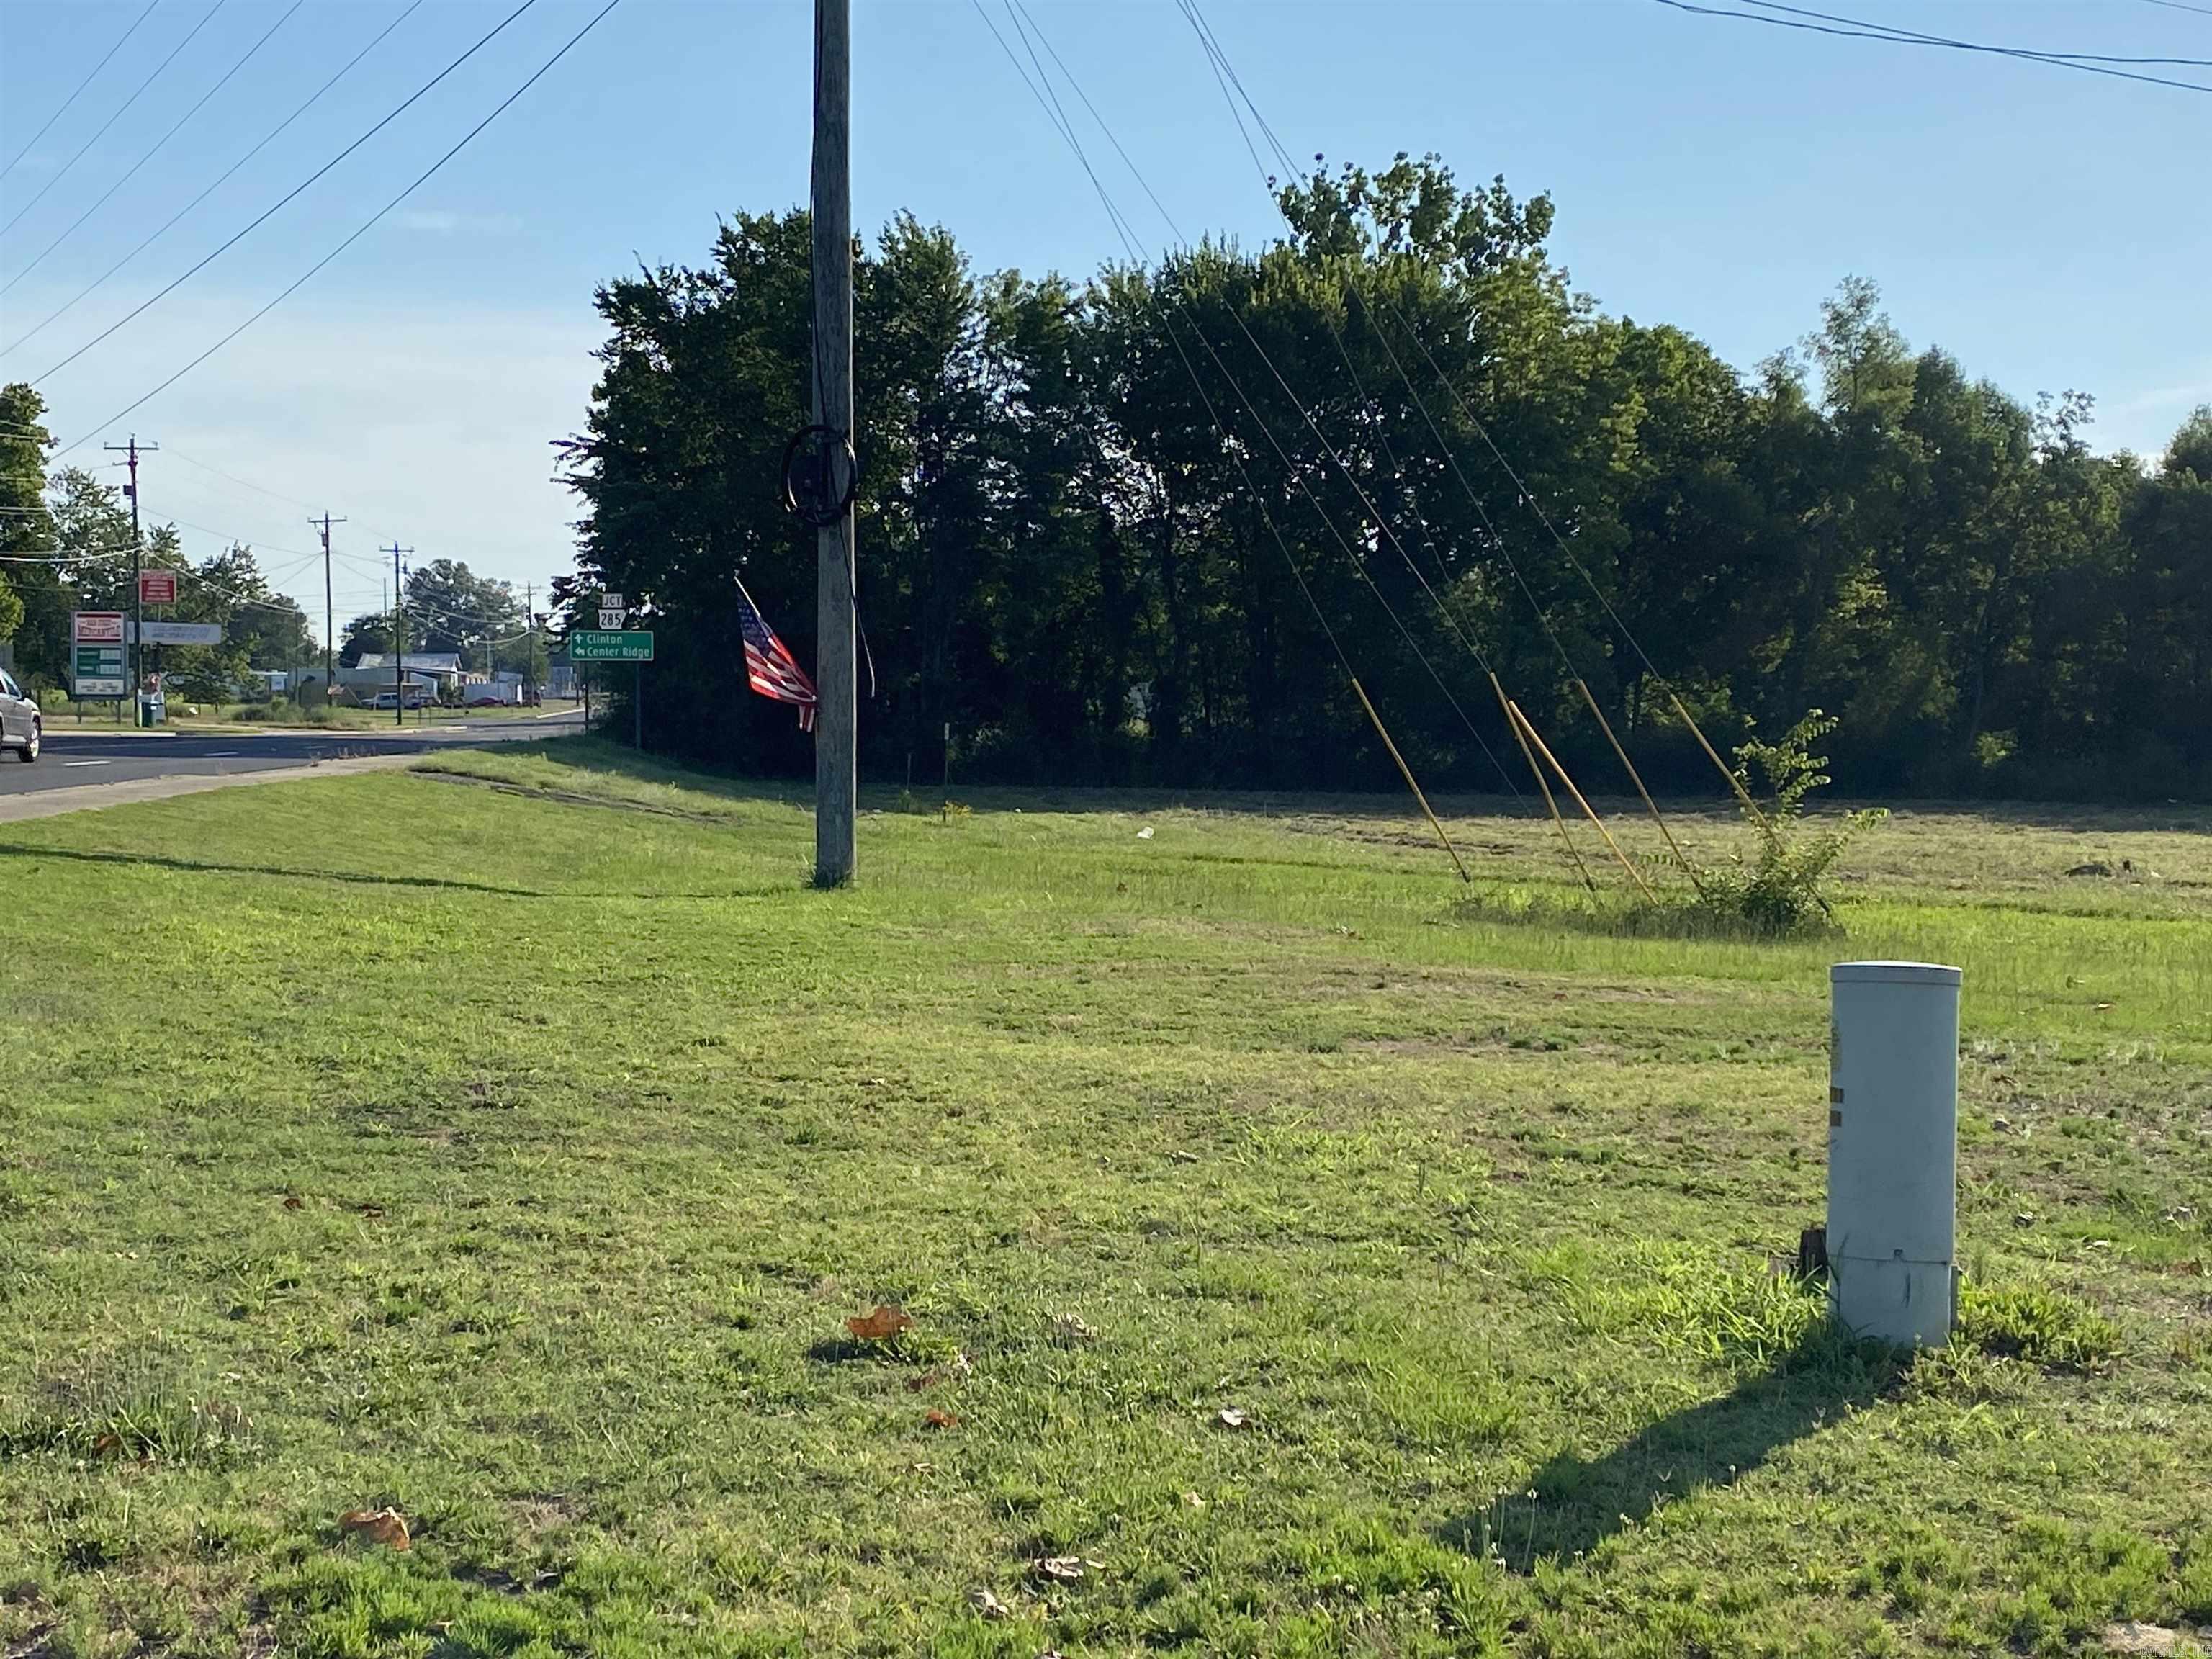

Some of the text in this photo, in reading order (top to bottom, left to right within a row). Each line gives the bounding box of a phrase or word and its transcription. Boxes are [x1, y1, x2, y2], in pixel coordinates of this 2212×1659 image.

[604, 595, 622, 606] JCT
[601, 613, 621, 626] 285
[586, 634, 623, 644] Clinton
[587, 647, 649, 659] Center Ridge
